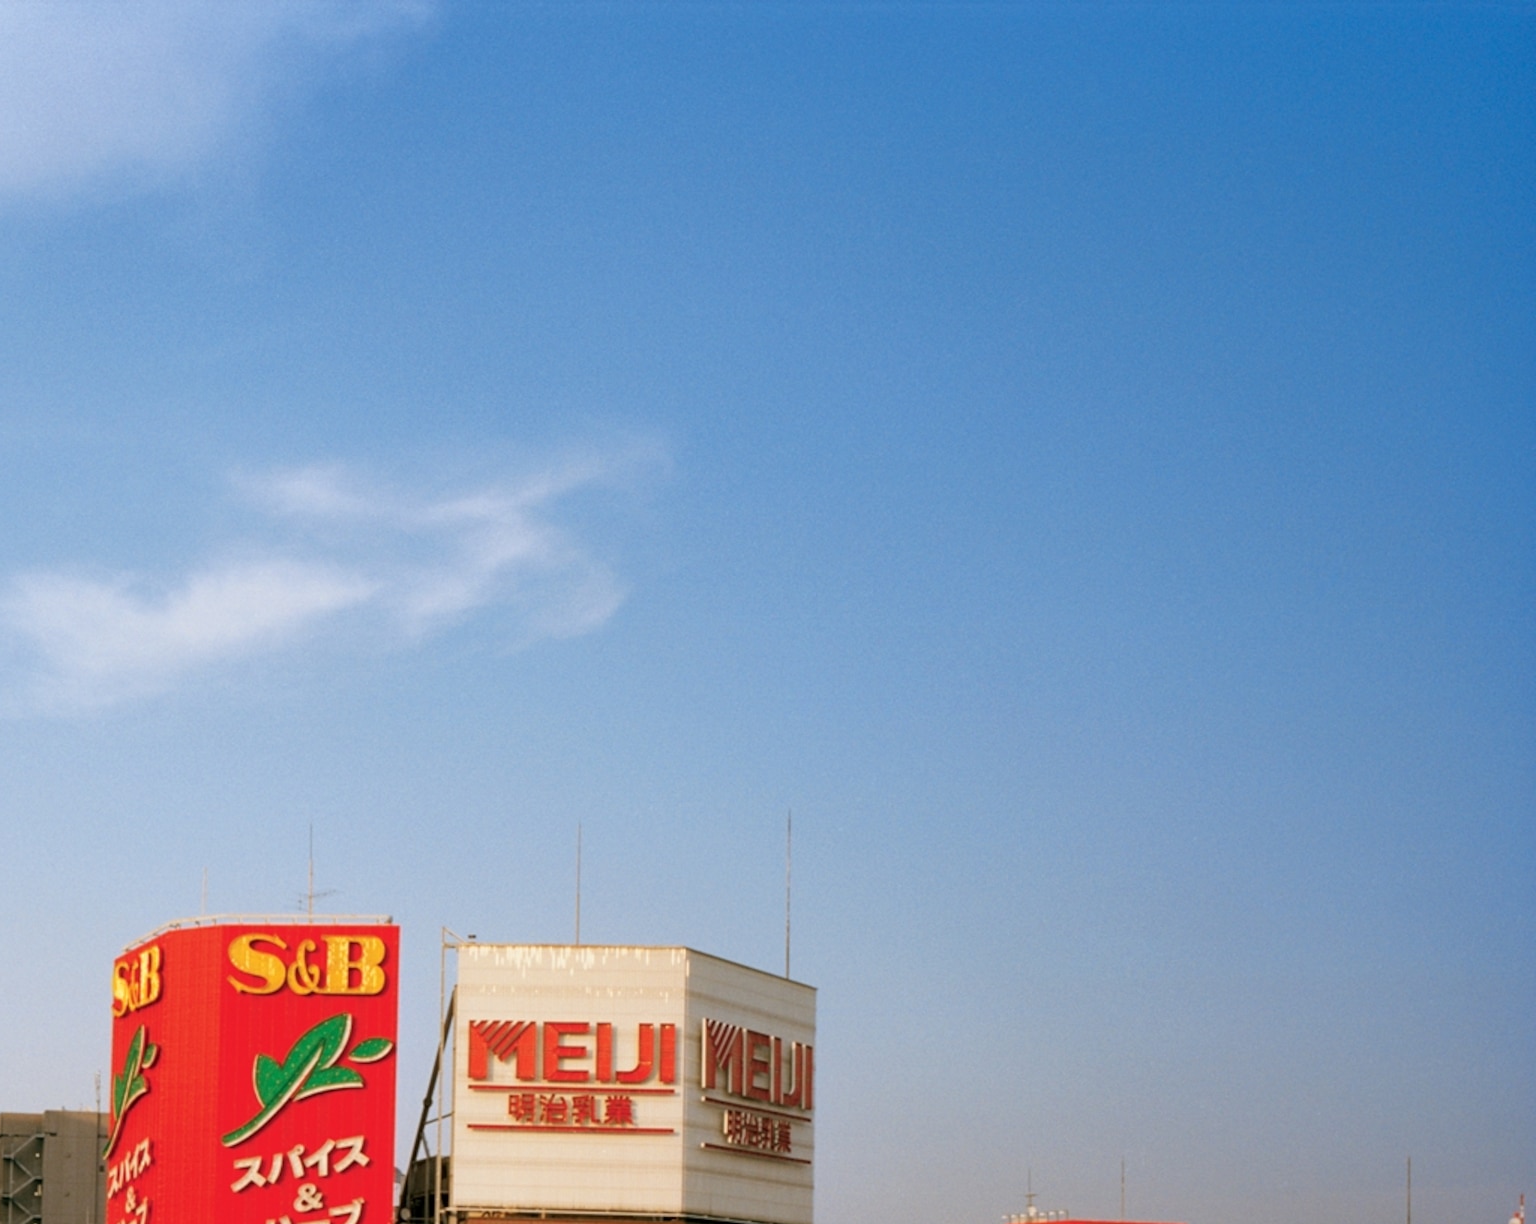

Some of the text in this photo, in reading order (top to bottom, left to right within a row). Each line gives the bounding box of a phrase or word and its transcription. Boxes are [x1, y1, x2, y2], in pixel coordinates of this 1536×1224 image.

[111, 944, 162, 1018] S&B
[227, 933, 386, 996] S&B
[467, 1019, 677, 1084] MEIJI
[701, 1017, 814, 1111] MEIJI
[508, 1094, 634, 1125] 明治乳業
[723, 1109, 792, 1153] 明治乳業
[107, 1138, 152, 1198] スパイス
[230, 1134, 371, 1195] スパイス
[124, 1186, 138, 1212] &
[292, 1182, 324, 1213] &
